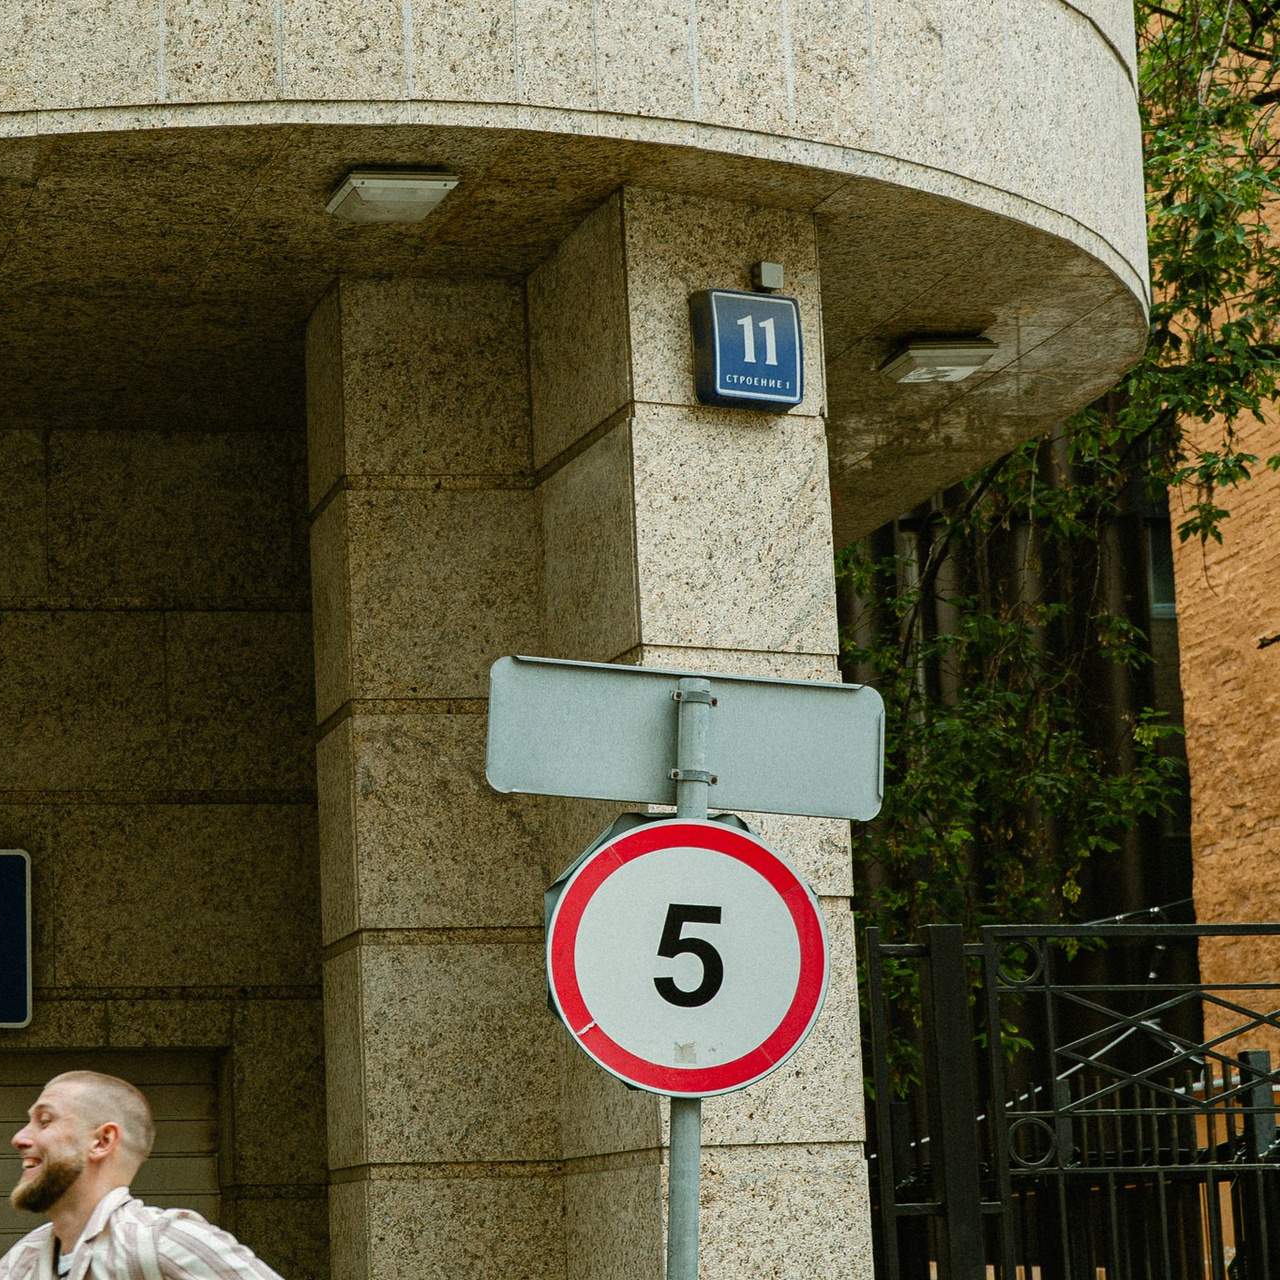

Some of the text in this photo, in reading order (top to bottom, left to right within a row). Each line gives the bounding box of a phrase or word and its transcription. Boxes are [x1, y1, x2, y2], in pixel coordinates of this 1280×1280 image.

[736, 315, 778, 366] 11
[725, 374, 783, 388] СТРОЕНИЕ
[653, 903, 725, 1008] 5
